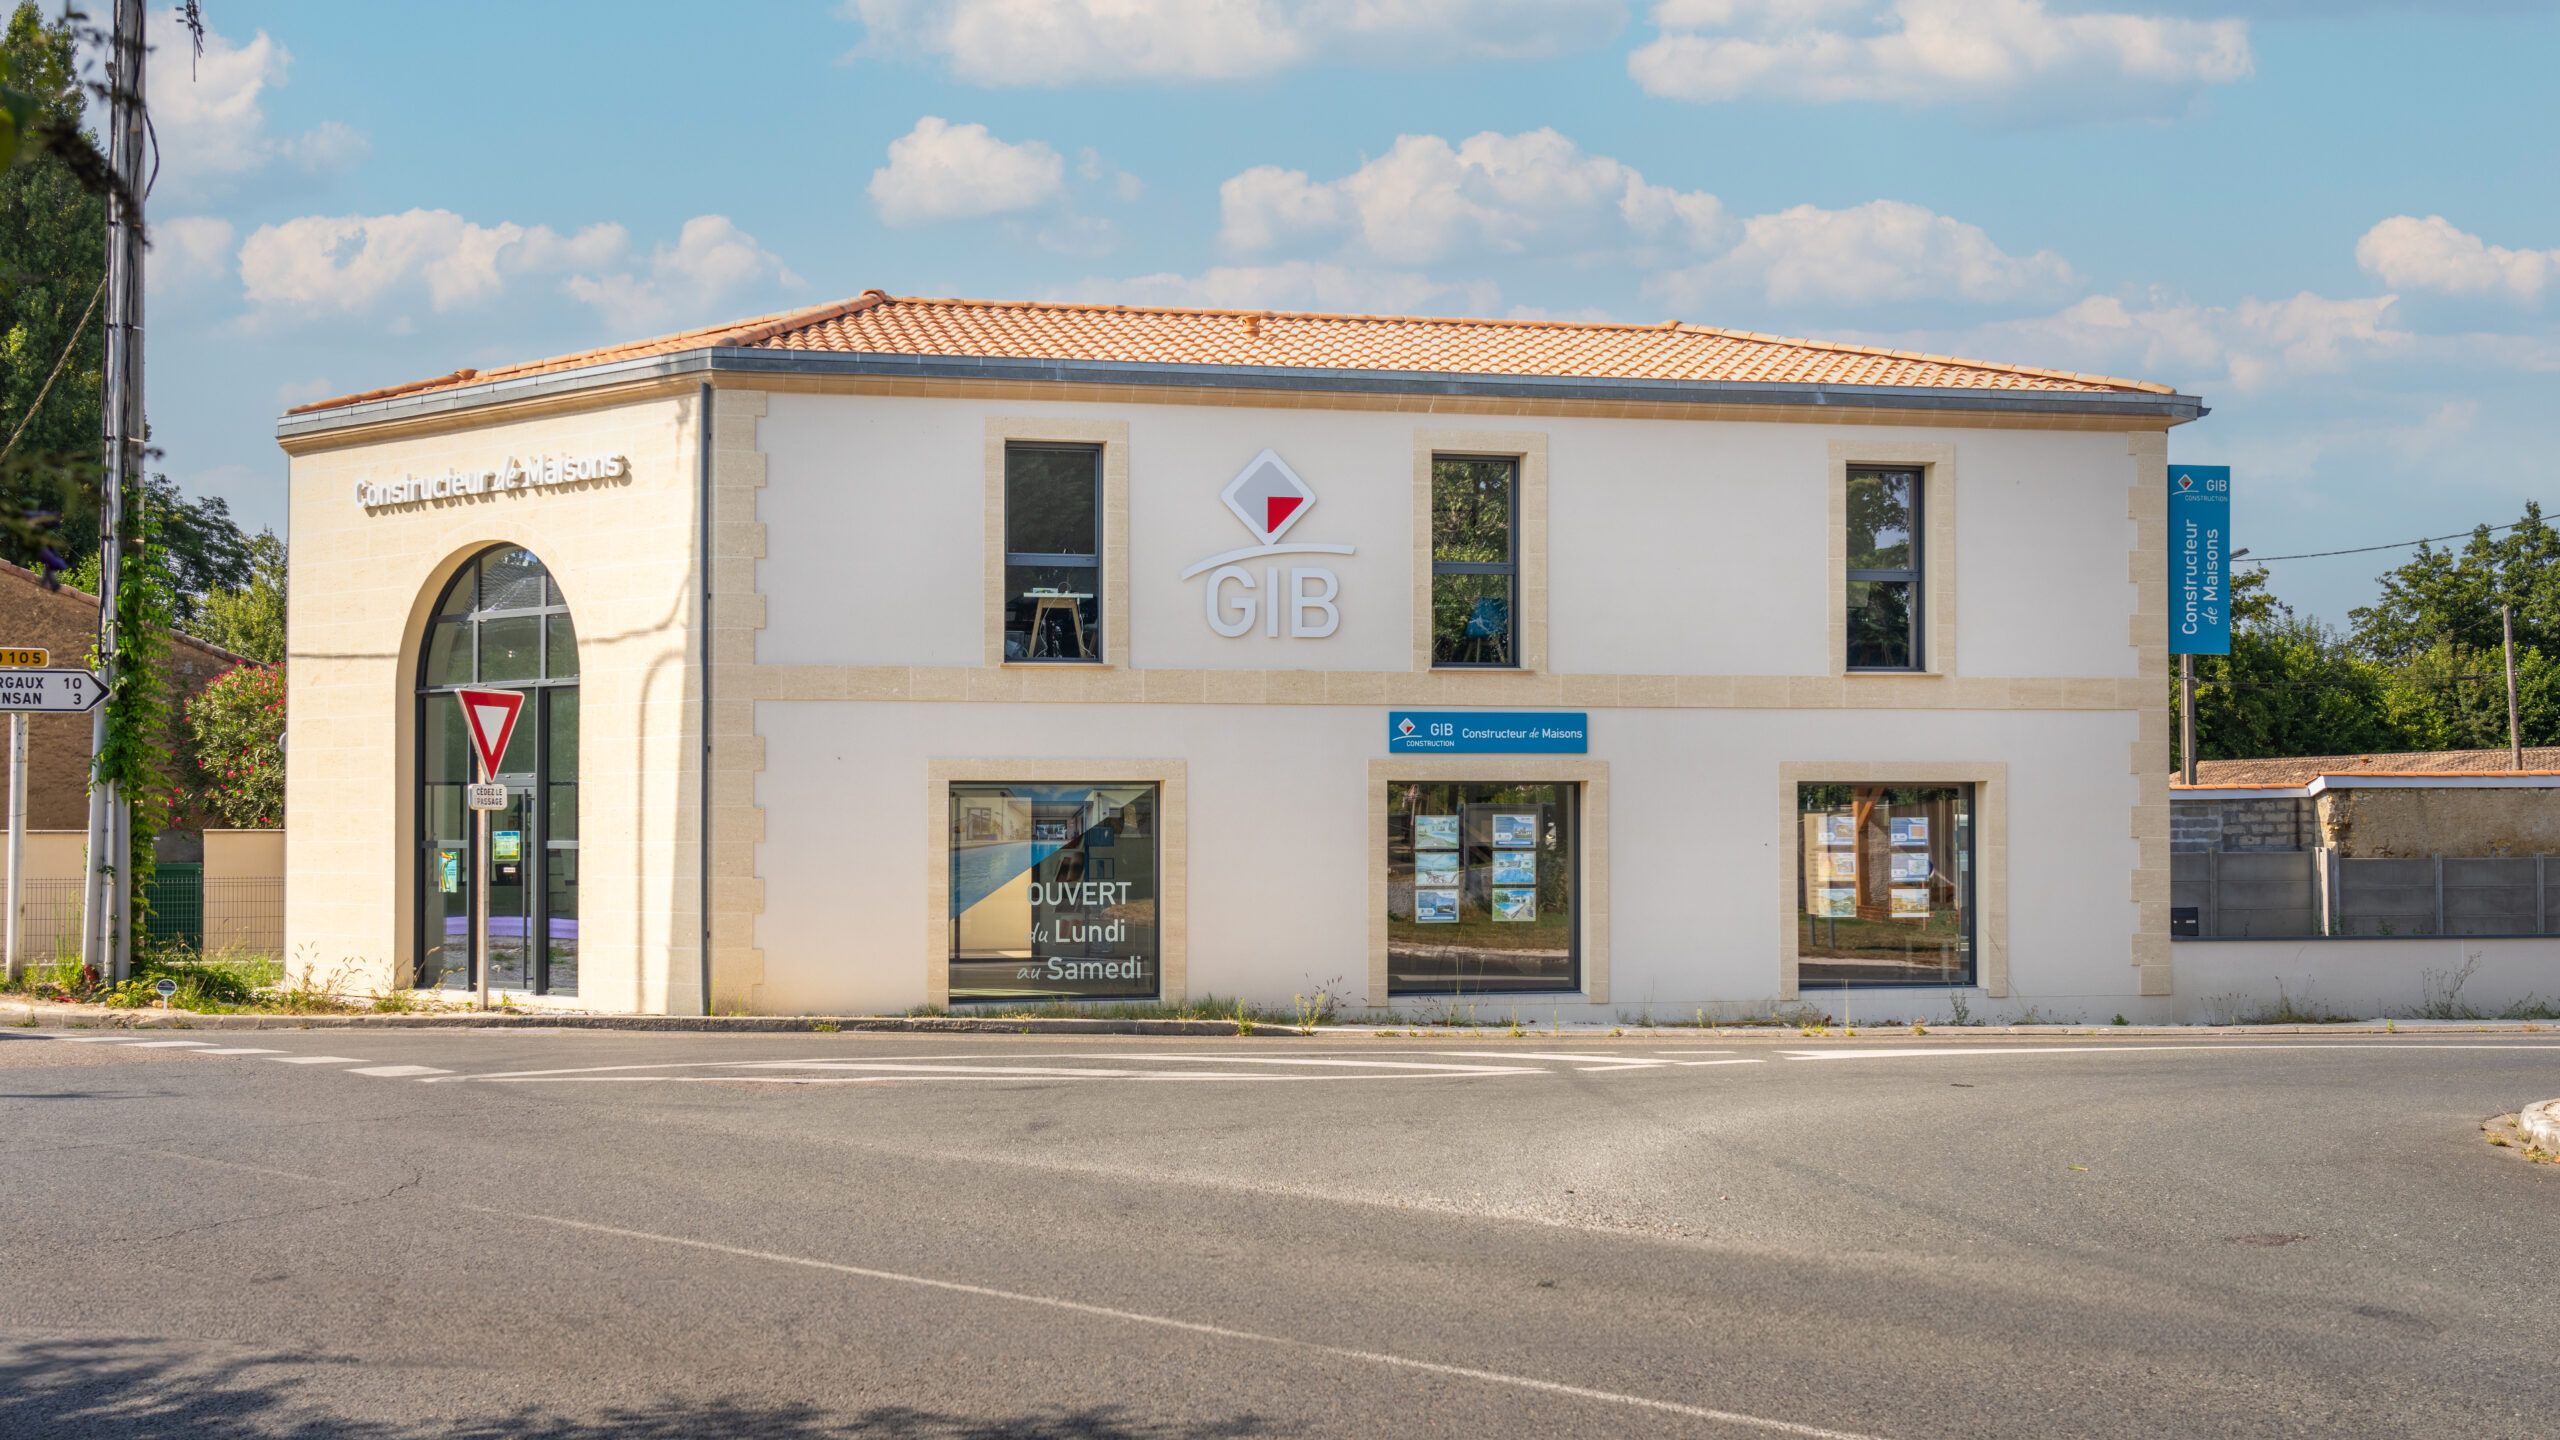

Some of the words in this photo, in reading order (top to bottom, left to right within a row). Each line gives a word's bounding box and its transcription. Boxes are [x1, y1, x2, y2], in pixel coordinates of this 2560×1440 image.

[354, 467, 494, 508] Constructeur
[495, 455, 520, 490] de
[523, 451, 624, 486] Maisons
[2207, 479, 2227, 492] GIB
[2203, 528, 2218, 601] Maisons
[2182, 519, 2198, 635] Constructeur
[1206, 565, 1340, 638] GIB
[2201, 606, 2218, 625] de
[64, 678, 82, 689] 10
[73, 693, 81, 705] 3
[1430, 723, 1454, 736] GIB
[1462, 728, 1527, 739] Constructeur
[1529, 727, 1539, 739] de
[1542, 728, 1583, 739] Maisons
[476, 797, 503, 806] PASSAGE
[496, 788, 503, 796] LE
[1027, 881, 1132, 906] OUVERT
[1028, 922, 1048, 943] du
[1055, 919, 1125, 943] Lundi
[1016, 967, 1041, 980] au
[1047, 955, 1141, 980] Samedi
